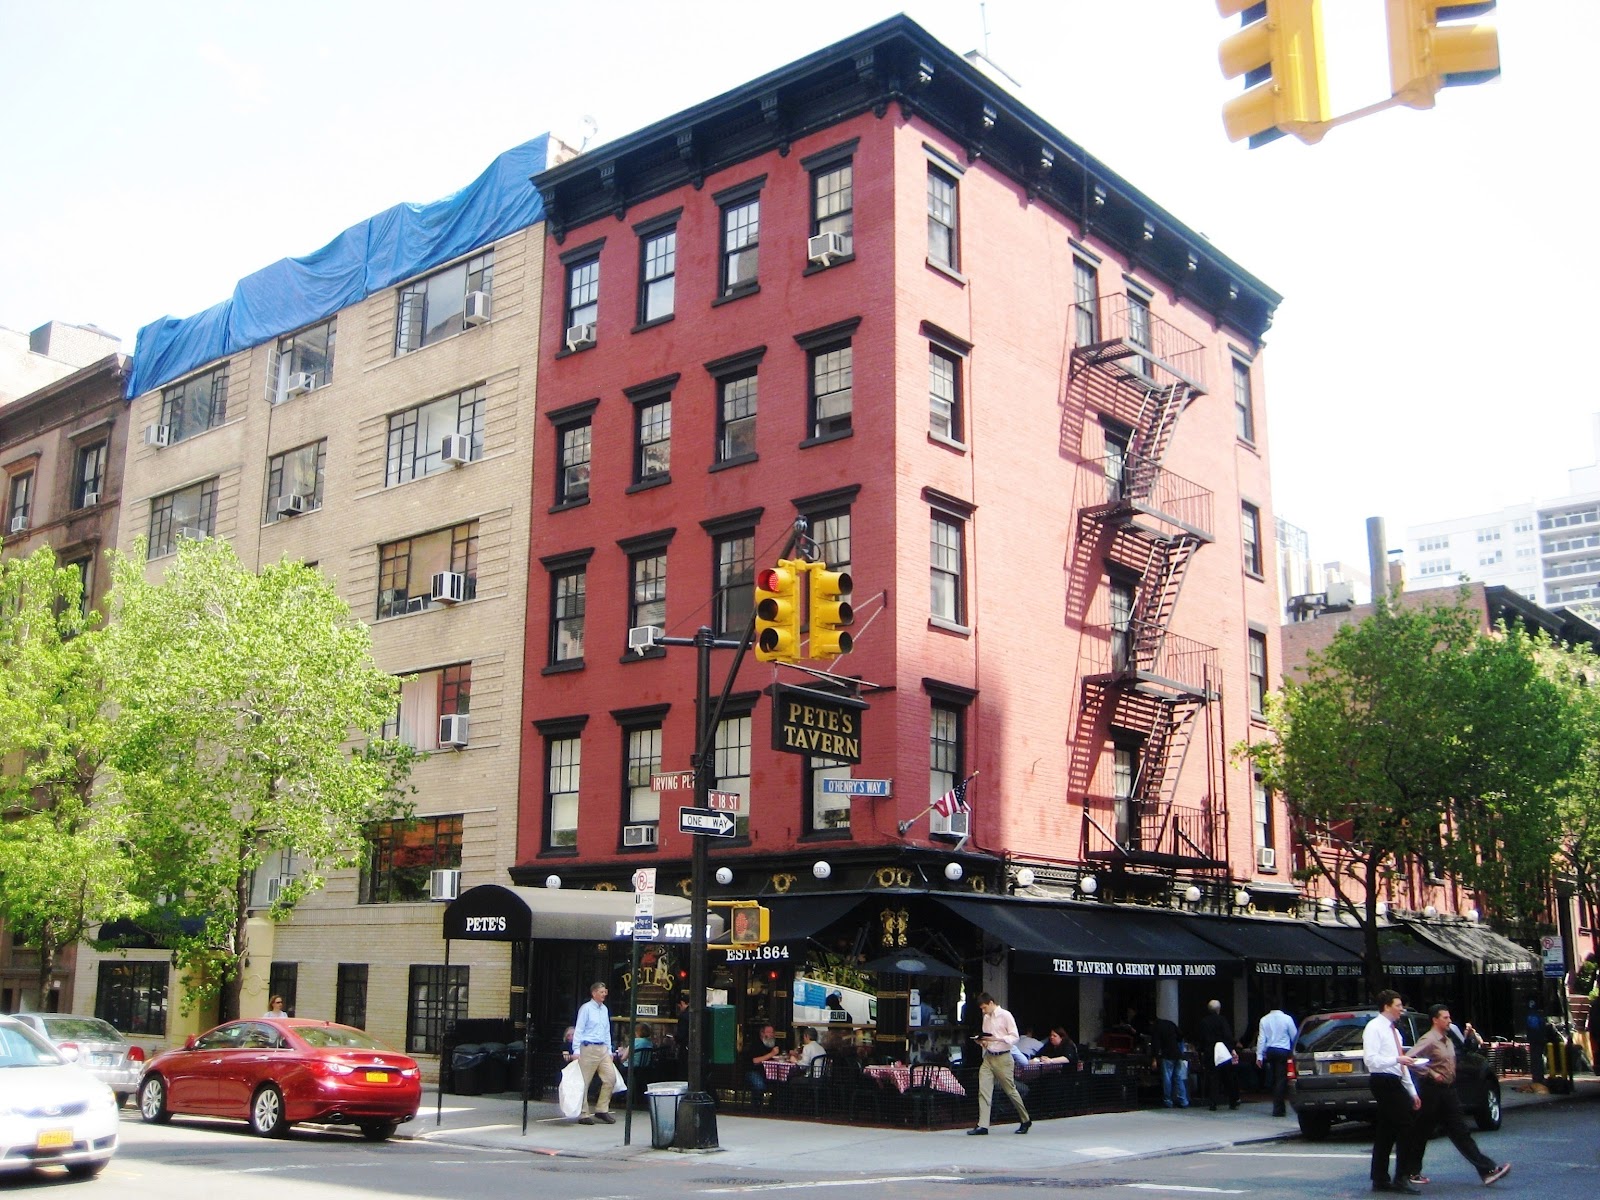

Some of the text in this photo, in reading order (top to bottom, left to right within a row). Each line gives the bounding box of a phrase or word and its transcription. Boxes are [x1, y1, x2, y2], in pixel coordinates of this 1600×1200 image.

[789, 703, 853, 734] PETE'S
[784, 725, 859, 758] TAVERN
[653, 776, 678, 791] IRVING
[828, 780, 881, 794] O'HENRY'S WAY
[710, 793, 738, 810] E 18 ST
[687, 815, 729, 829] ONE WAY
[465, 916, 507, 932] PETE'S
[1052, 959, 1074, 973] THE
[1076, 960, 1114, 975] TAVERN
[1158, 964, 1183, 976] MADE
[1184, 964, 1217, 976] FAMOUS
[1255, 962, 1282, 975] STEAKS
[1284, 964, 1304, 975] CHOPS
[1305, 965, 1334, 976] SEAFOOD
